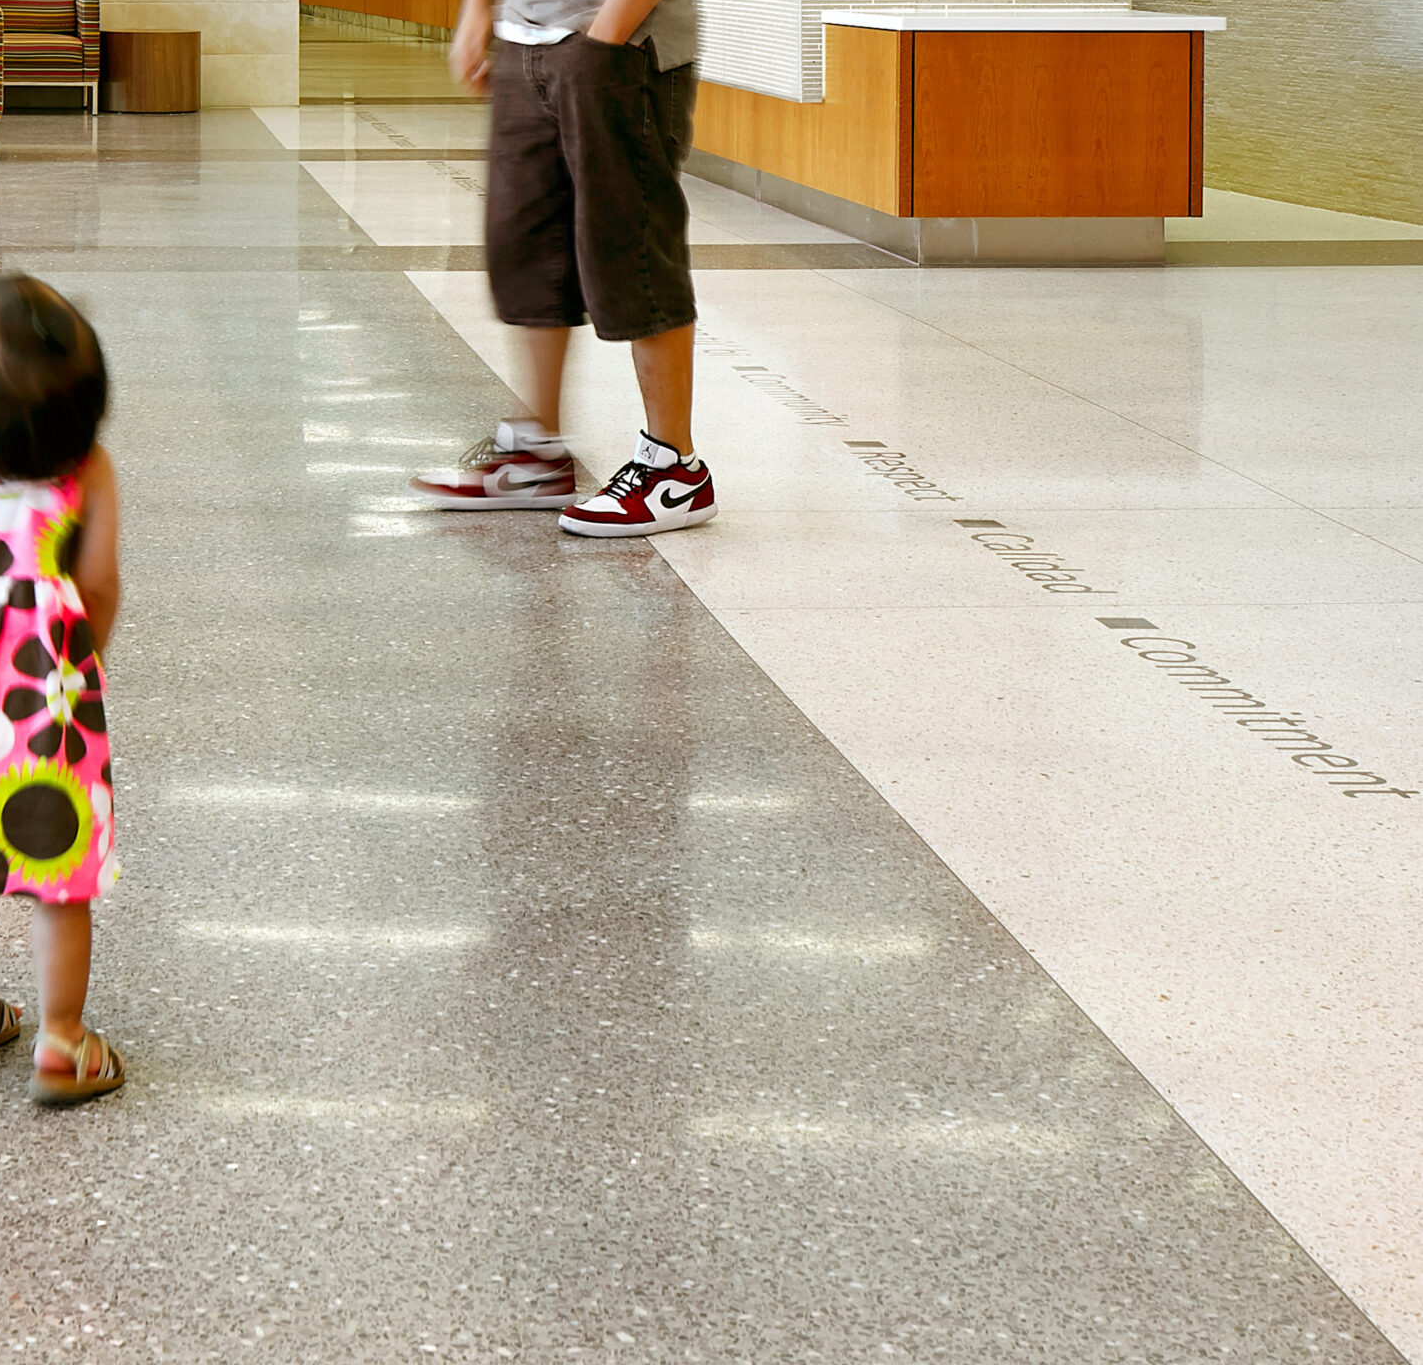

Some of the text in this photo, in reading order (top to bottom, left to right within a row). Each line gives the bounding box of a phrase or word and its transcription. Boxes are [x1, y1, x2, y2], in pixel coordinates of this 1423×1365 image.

[740, 373, 1421, 799] Community Respect Calidad Commitment
